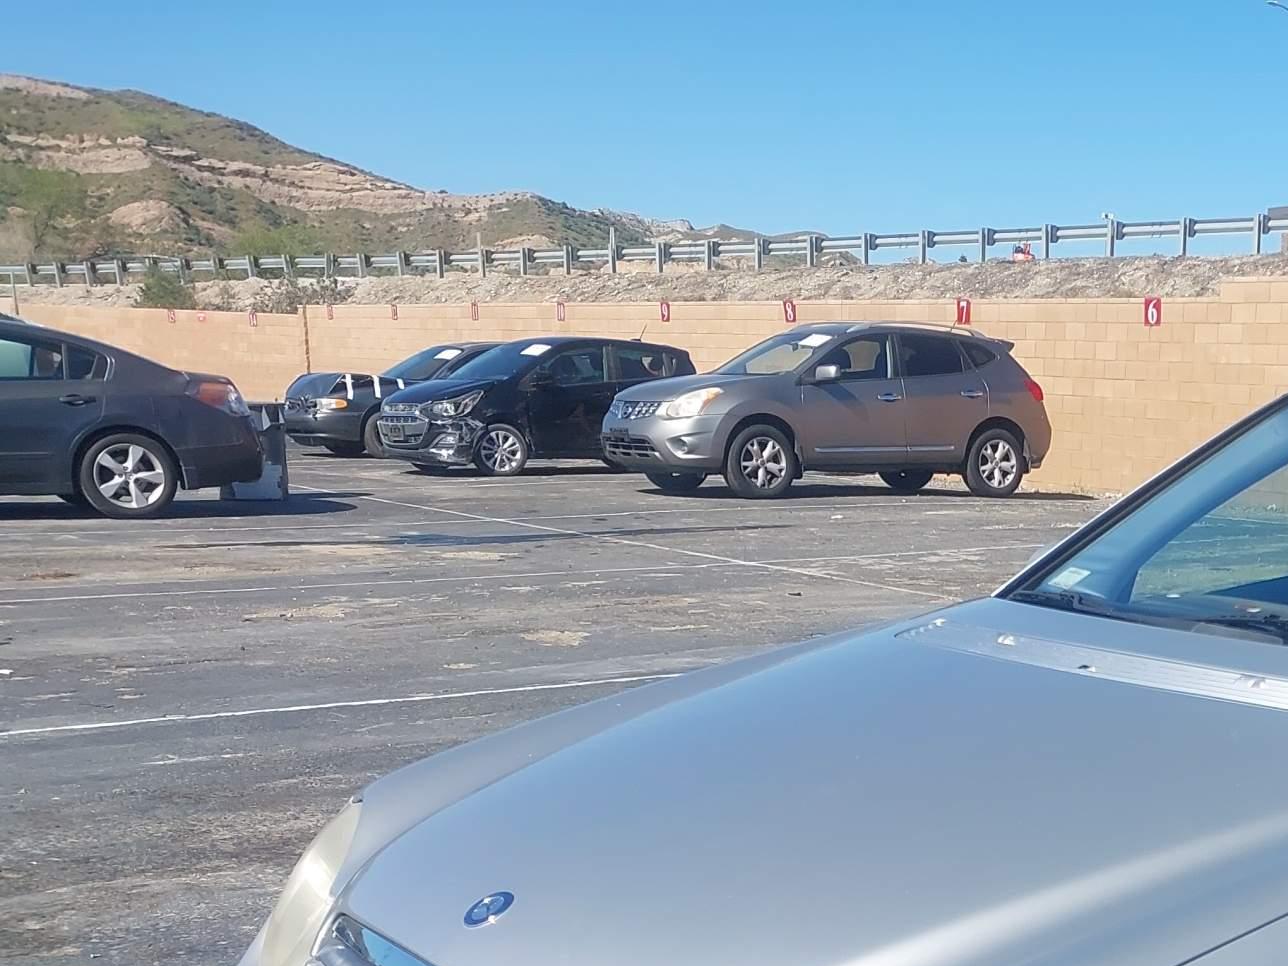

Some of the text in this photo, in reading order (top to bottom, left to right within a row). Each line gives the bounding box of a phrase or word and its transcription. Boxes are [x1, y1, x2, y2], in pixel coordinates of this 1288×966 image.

[662, 303, 669, 321] 9
[785, 302, 794, 321] 8
[959, 301, 968, 324] 7
[1147, 300, 1158, 324] 6
